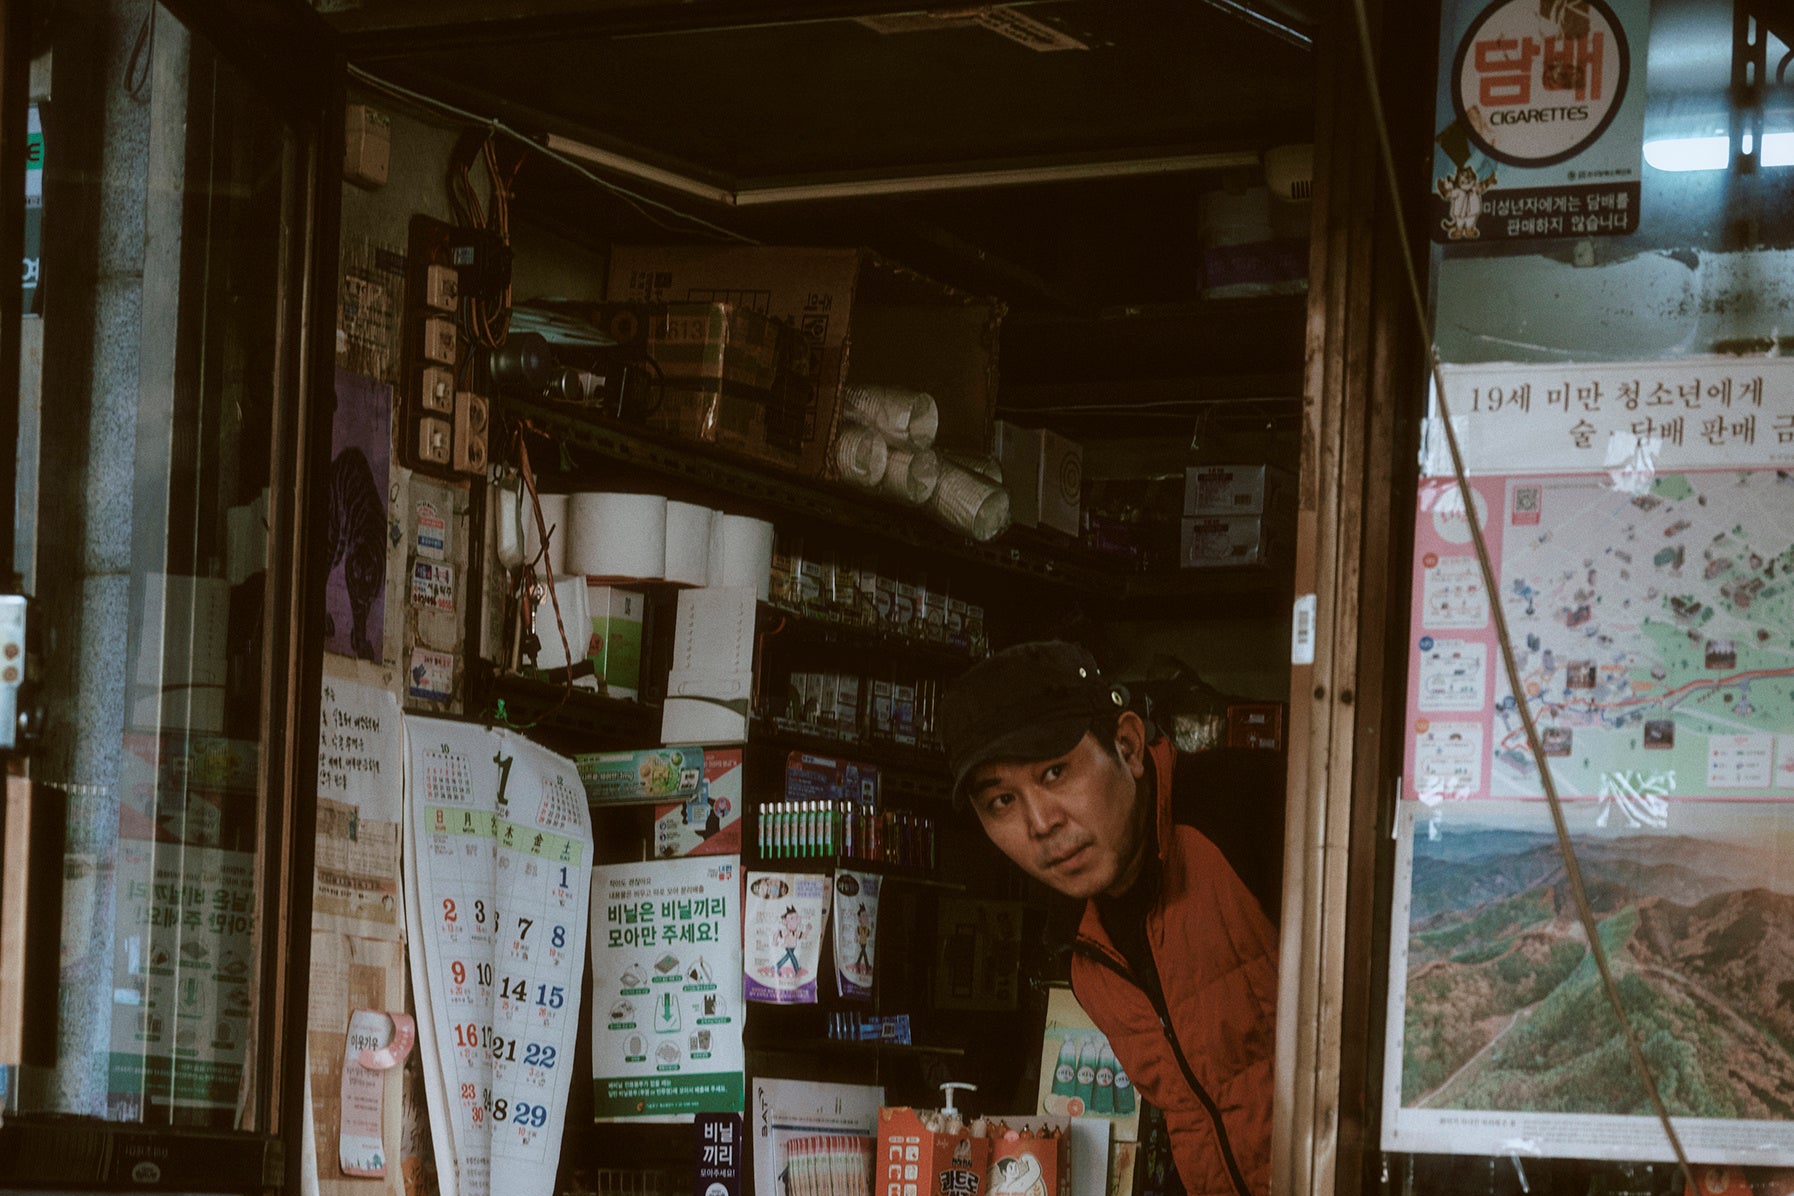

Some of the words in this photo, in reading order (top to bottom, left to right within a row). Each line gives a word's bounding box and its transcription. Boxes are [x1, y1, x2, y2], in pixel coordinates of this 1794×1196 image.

[1474, 32, 1605, 107] 담배
[1490, 105, 1589, 126] CIGARETTES
[1482, 194, 1582, 217] 미성년자에게는
[1587, 192, 1630, 212] 담배를
[1507, 216, 1564, 236] 판매하지
[1571, 212, 1629, 233] 않습니다
[1470, 383, 1531, 413] 19세
[1547, 381, 1604, 412] 미만
[1615, 376, 1764, 410] 청소년에게
[1569, 419, 1597, 449] 술
[1701, 415, 1757, 445] 판매
[465, 811, 472, 827] 月
[534, 832, 544, 847] 金
[559, 866, 568, 889] 1
[442, 898, 457, 922] 2
[475, 899, 485, 924] 3
[518, 917, 534, 940] 7
[551, 925, 565, 948] 8
[608, 901, 655, 925] 비닐은
[661, 896, 725, 920] 비닐끼리
[608, 926, 657, 948] 모아만
[662, 921, 718, 945] 주세요!
[451, 960, 466, 985] 9
[476, 962, 492, 987] 10
[500, 976, 527, 1002] 14
[535, 983, 564, 1009] 15
[454, 1023, 478, 1048] 16
[481, 1025, 492, 1049] 17
[492, 1036, 516, 1062] 21
[523, 1042, 556, 1069] 22
[461, 1083, 476, 1100] 23
[492, 1098, 508, 1121] 8
[513, 1102, 547, 1128] 29
[471, 1106, 484, 1123] 30
[704, 1122, 733, 1143] 비닐
[703, 1144, 733, 1167] 끼리
[700, 1168, 735, 1179] 모아주세요!
